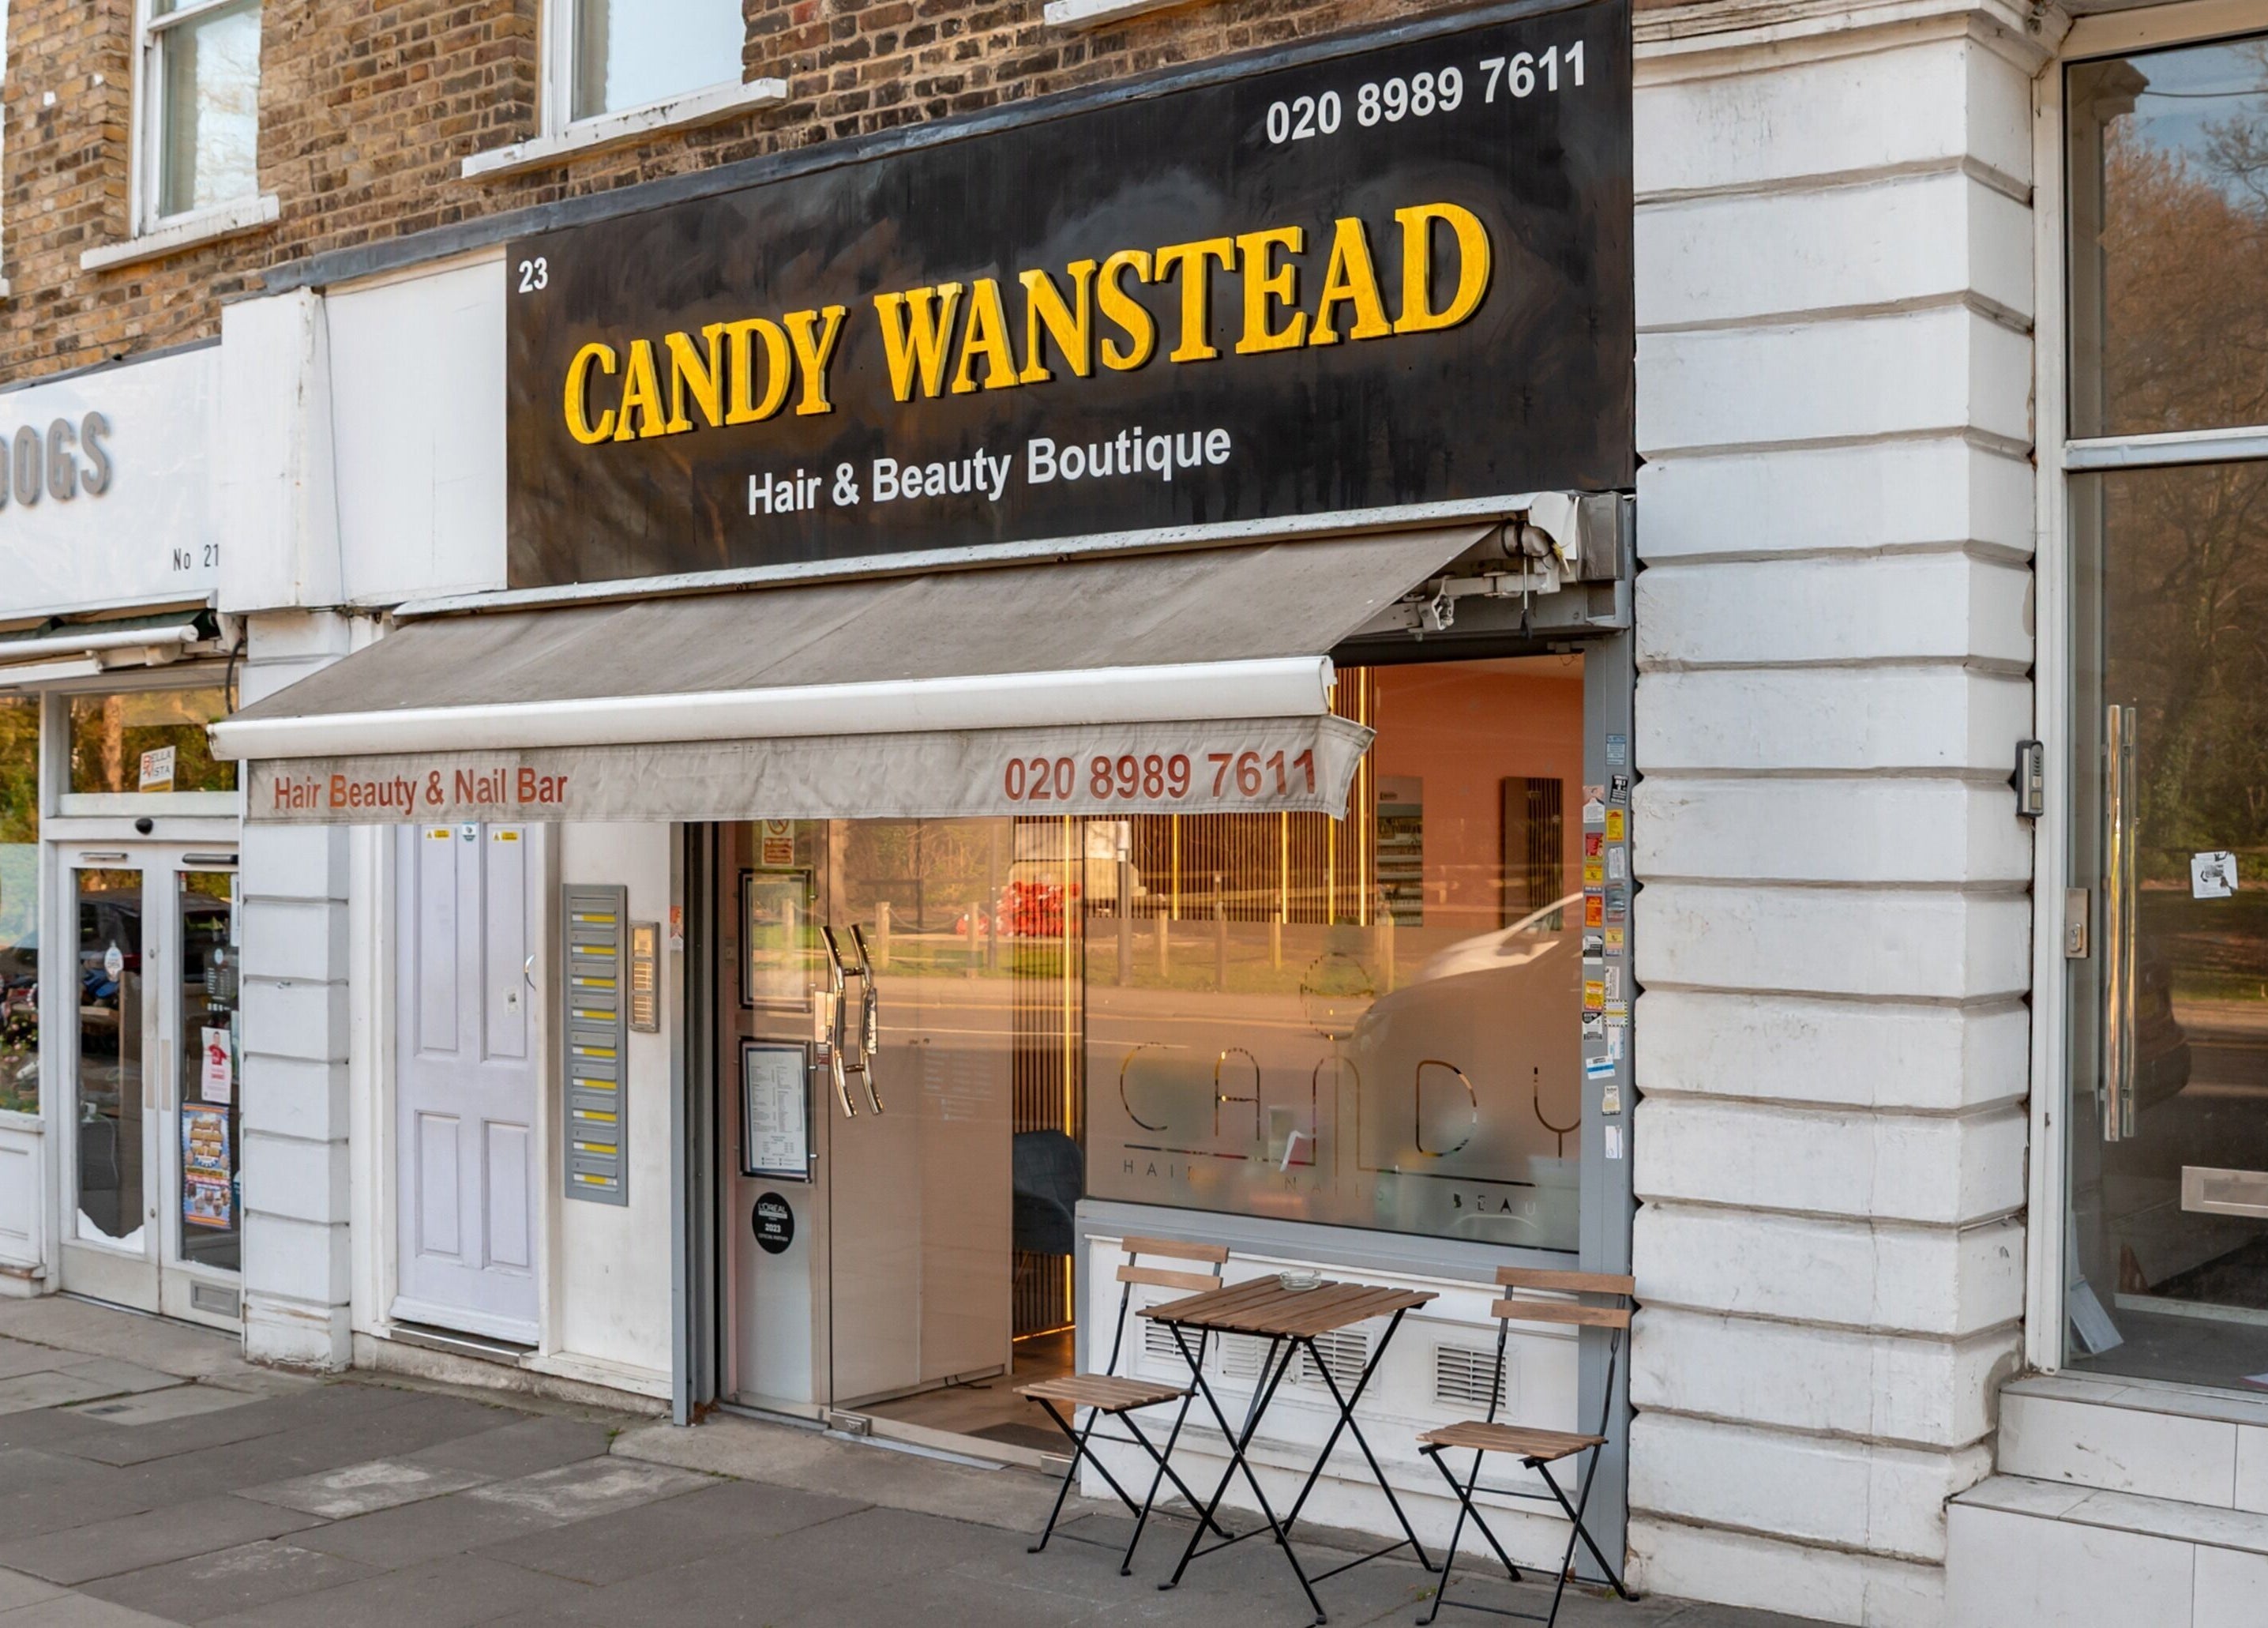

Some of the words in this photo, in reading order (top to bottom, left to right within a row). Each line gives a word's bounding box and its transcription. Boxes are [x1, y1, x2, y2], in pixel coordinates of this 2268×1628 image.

[1267, 90, 1342, 145] 020
[1357, 66, 1463, 127] 8989
[1479, 40, 1584, 103] 7611
[518, 258, 548, 293] 23
[564, 305, 846, 445] CANDY
[873, 202, 1489, 402] WANSTEAD
[0, 411, 112, 512] OGS
[748, 470, 821, 516] Hair
[832, 462, 861, 507] &
[873, 447, 1012, 502] Beauty
[1027, 427, 1231, 482] Boutique
[173, 548, 191, 571] No
[204, 543, 220, 567] 21
[275, 776, 321, 810] Hair
[329, 774, 417, 816] Beauty
[426, 770, 445, 806] &
[455, 769, 506, 804] Nail
[517, 767, 567, 803] Bar
[1004, 757, 1076, 801] 020
[1090, 753, 1191, 800] 8989
[1207, 748, 1316, 797] 7611
[1119, 1041, 1581, 1167] CANDY
[1454, 1194, 1562, 1218] BEAU
